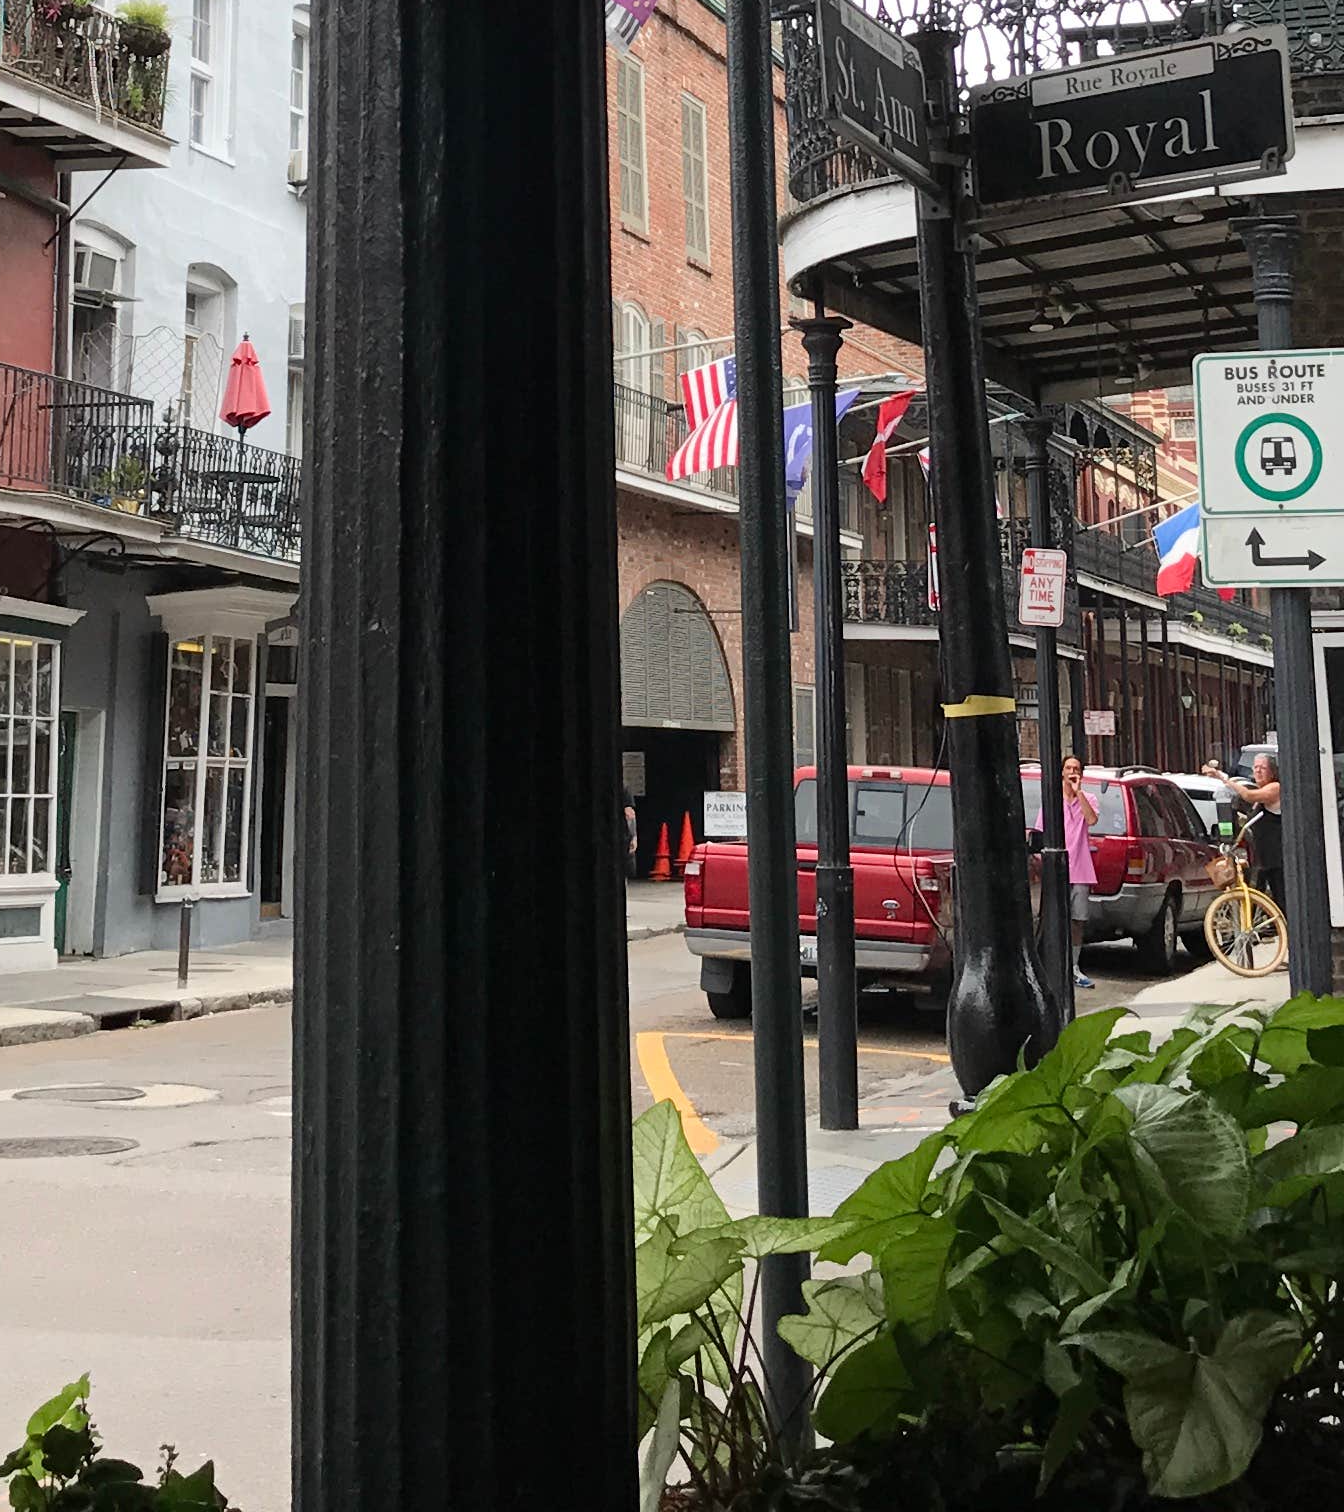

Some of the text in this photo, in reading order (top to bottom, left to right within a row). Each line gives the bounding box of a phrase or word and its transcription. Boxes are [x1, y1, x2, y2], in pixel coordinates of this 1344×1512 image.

[1066, 59, 1178, 95] Rue Royale
[835, 36, 918, 146] St. Ann
[1036, 89, 1220, 180] Royal
[1224, 364, 1325, 380] BUS ROUTE
[1237, 381, 1313, 393] BUSES 31 FT
[1237, 394, 1314, 405] AND UNDER
[1030, 577, 1055, 589] ANY
[1030, 590, 1055, 602] TIME
[707, 804, 745, 812] PARKIN
